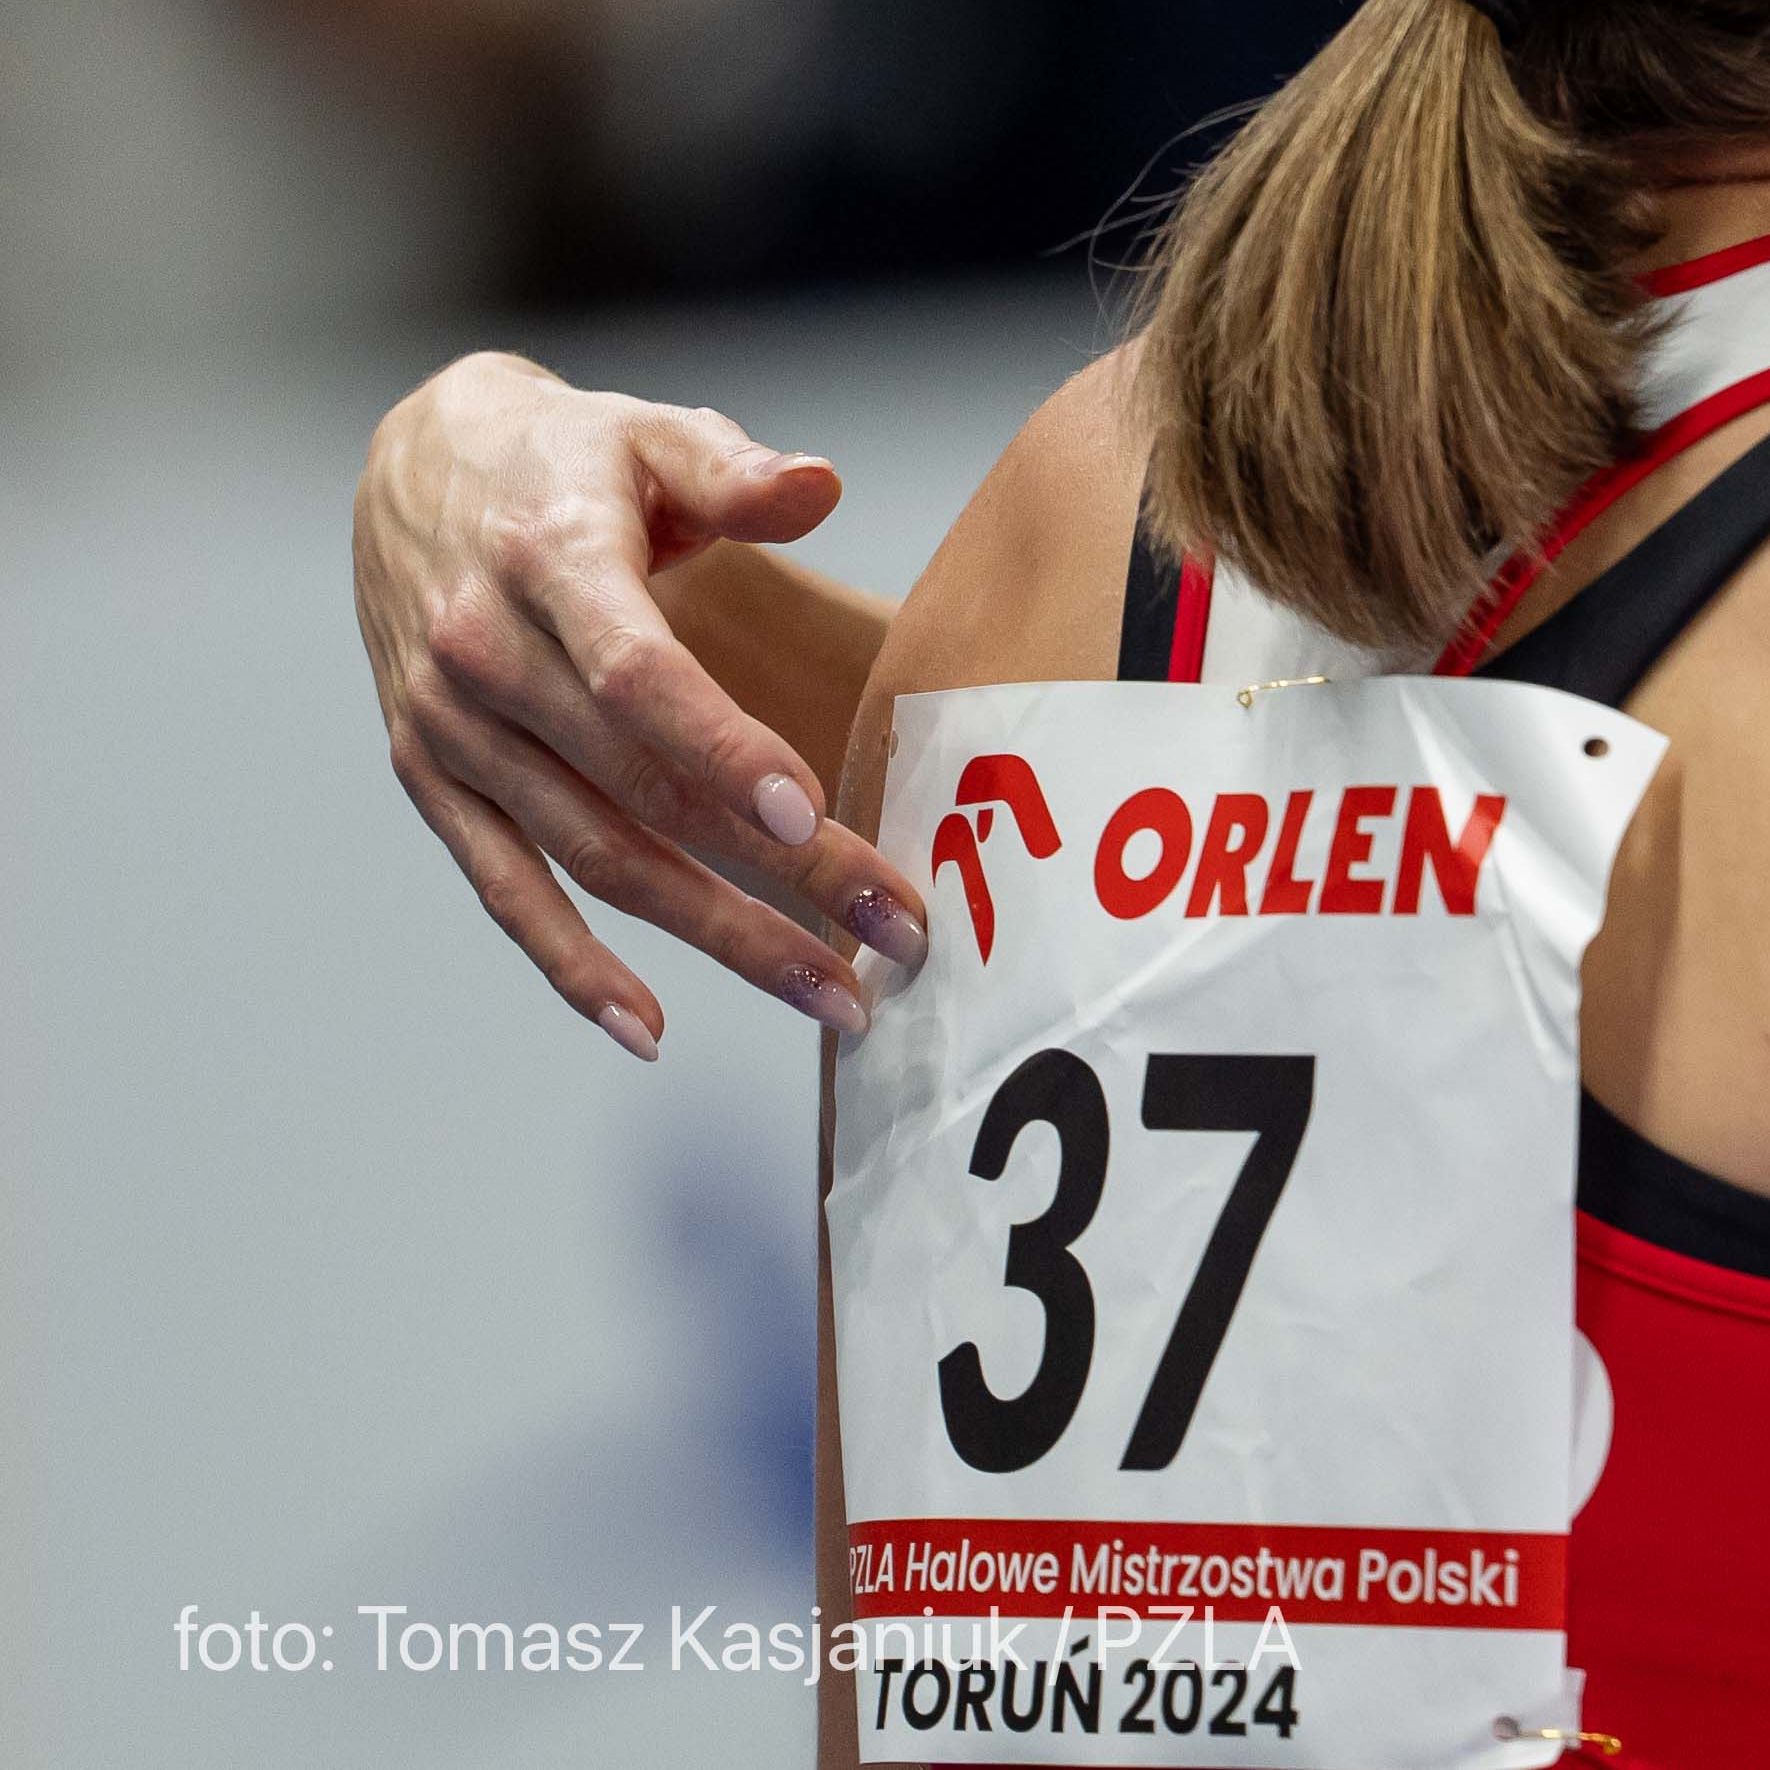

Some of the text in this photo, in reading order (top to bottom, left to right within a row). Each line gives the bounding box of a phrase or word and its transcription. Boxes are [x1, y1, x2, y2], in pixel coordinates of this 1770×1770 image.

[1094, 785, 1507, 921] ORLEN
[938, 1048, 1316, 1474] 37
[849, 1539, 1519, 1607] PZLA Halowe Mistrzostwa Polski
[873, 1635, 1298, 1738] TORUŃ 2024
